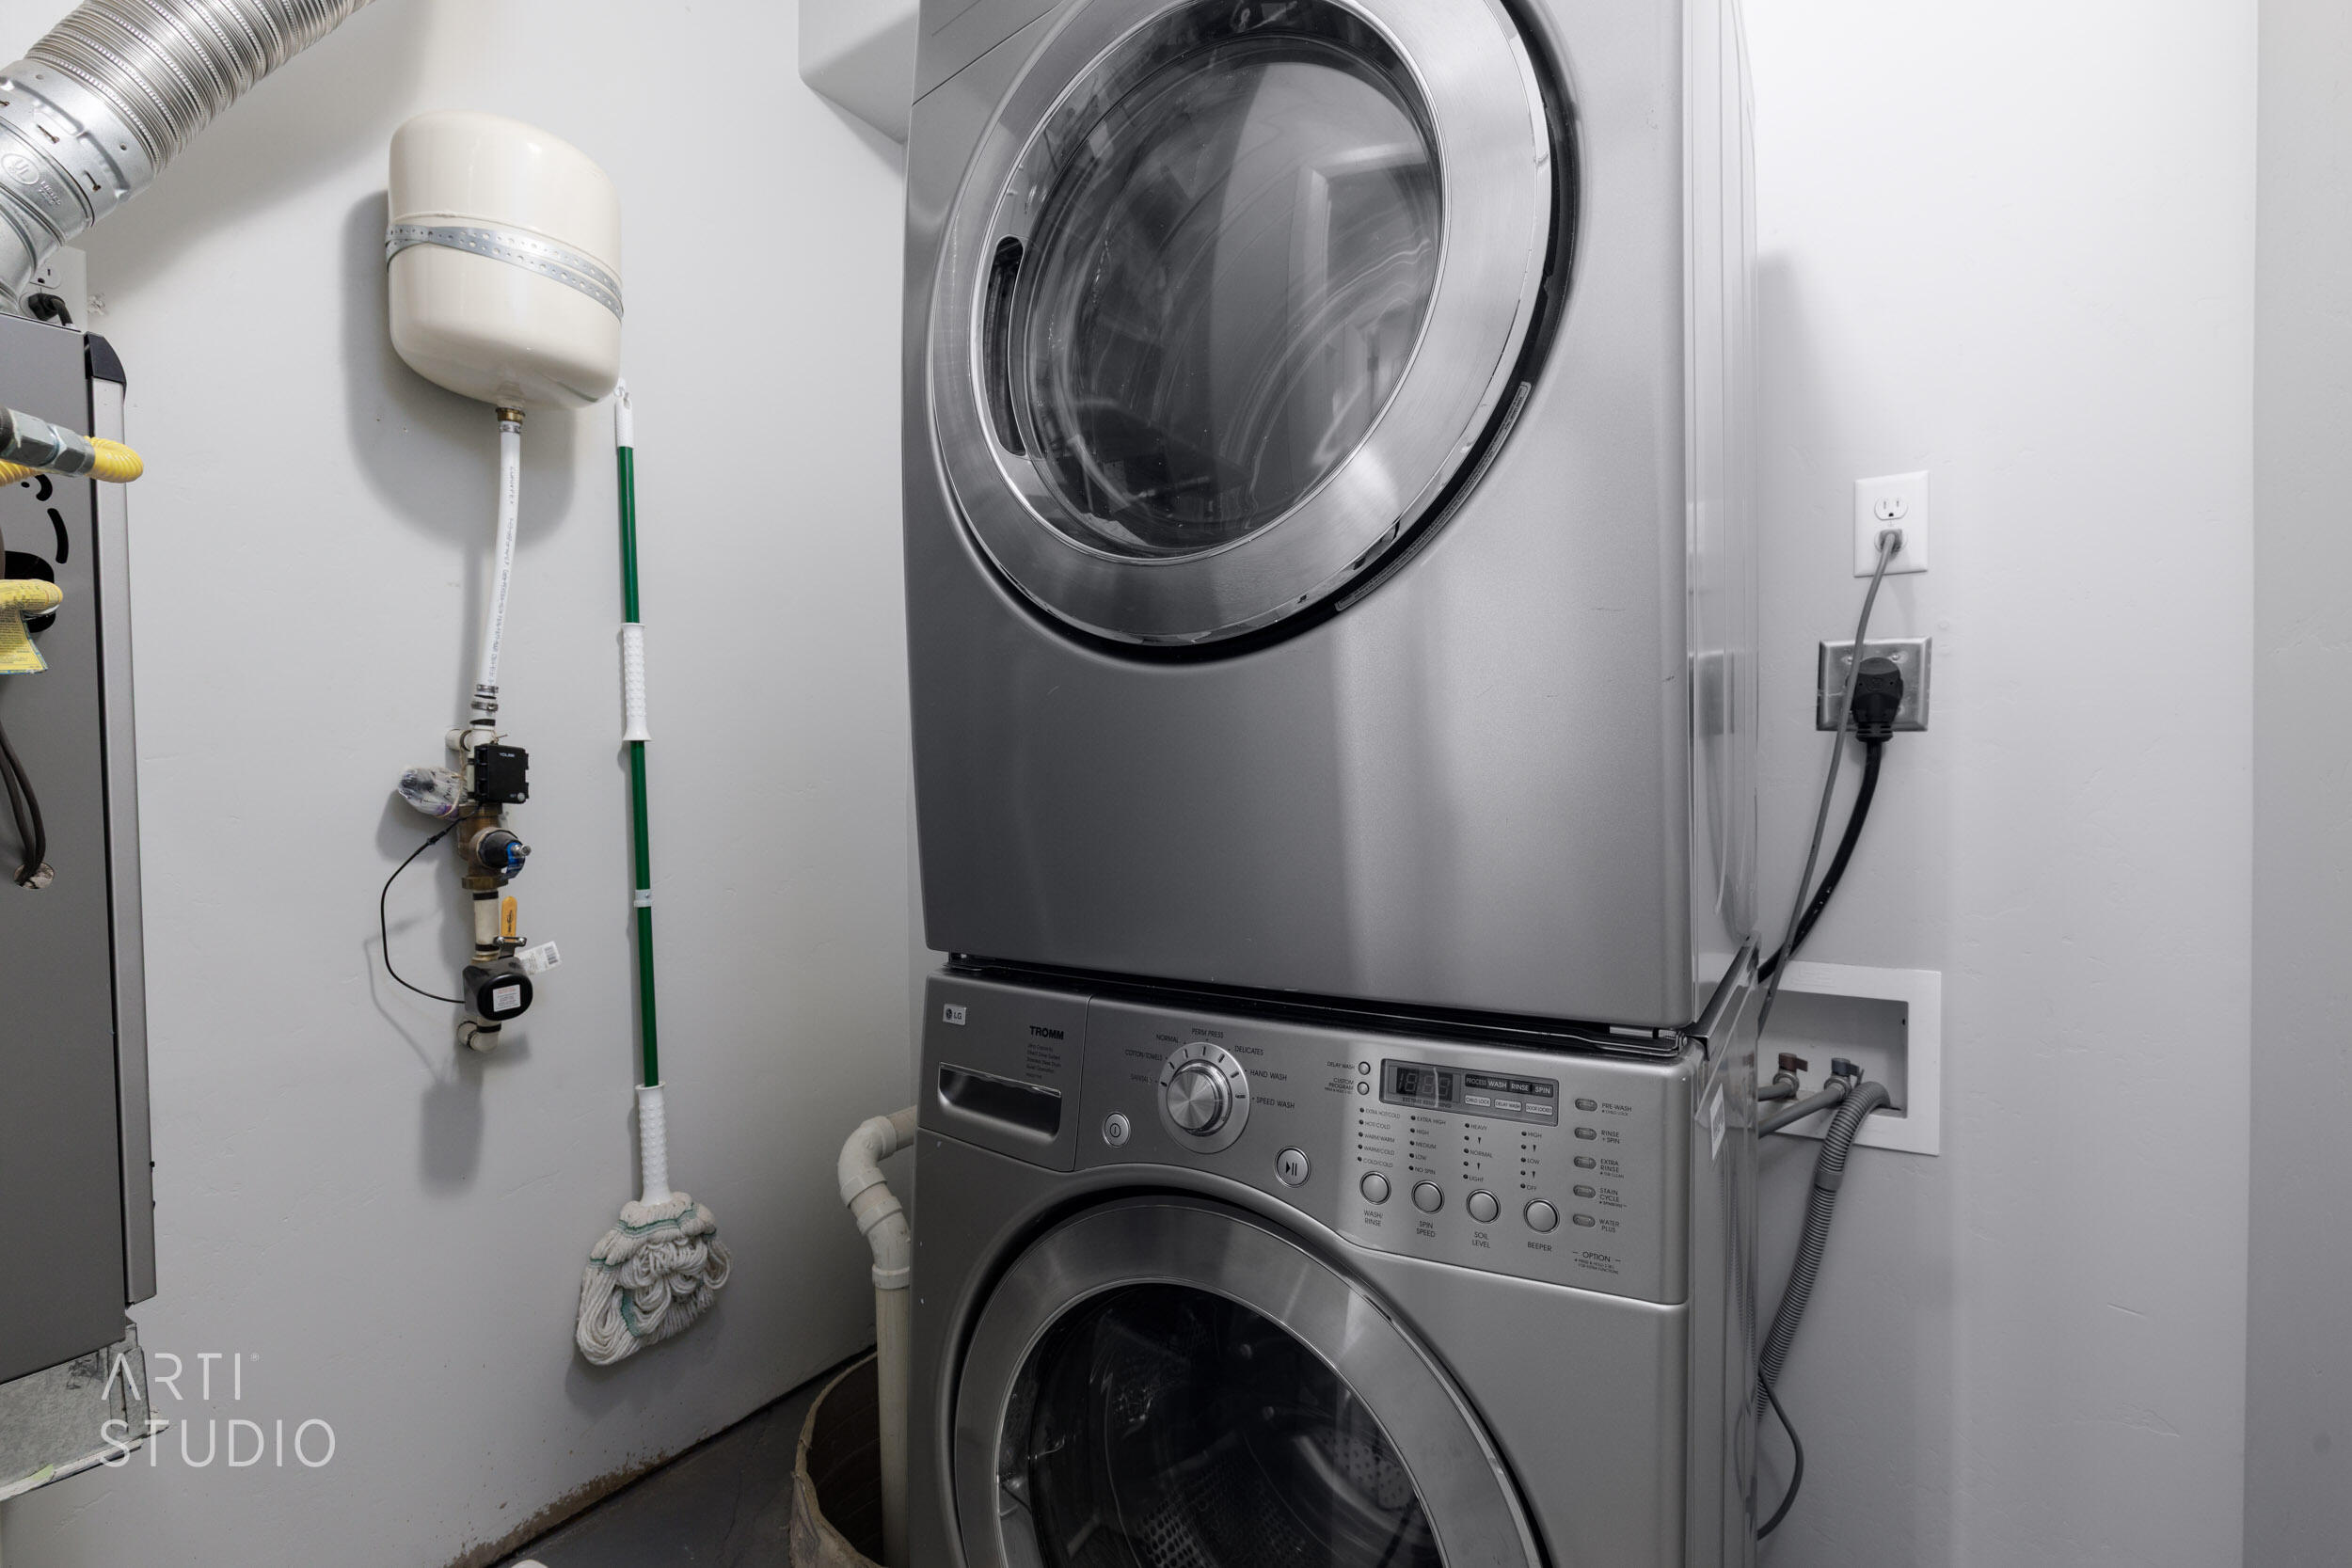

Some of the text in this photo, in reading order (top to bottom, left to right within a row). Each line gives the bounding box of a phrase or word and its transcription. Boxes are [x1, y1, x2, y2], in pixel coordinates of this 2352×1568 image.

[953, 1011, 962, 1020] LG
[1029, 1025, 1065, 1040] TROMM
[1191, 1027, 1224, 1038] PERM PRESS
[1156, 1034, 1179, 1043] NORMAL
[1234, 1045, 1264, 1055] DELICATES
[1249, 1069, 1288, 1081] HAND WASH
[1488, 1080, 1507, 1088] WASH
[1511, 1083, 1529, 1091] RINSE
[1534, 1085, 1550, 1094] SPIN
[1256, 1096, 1295, 1109] SPEED WASH
[1602, 1102, 1632, 1112] PRE-WASH
[1470, 1149, 1493, 1158] NORMAL
[1600, 1164, 1619, 1173] RINSE
[1364, 1218, 1382, 1227] RINSE
[1419, 1220, 1433, 1228] SPIN
[1416, 1227, 1436, 1238] SPEED
[1474, 1231, 1488, 1240] SOIL
[1472, 1239, 1490, 1248] LEVEL
[1527, 1242, 1552, 1252] BEEPER
[1582, 1251, 1611, 1262] OPTION
